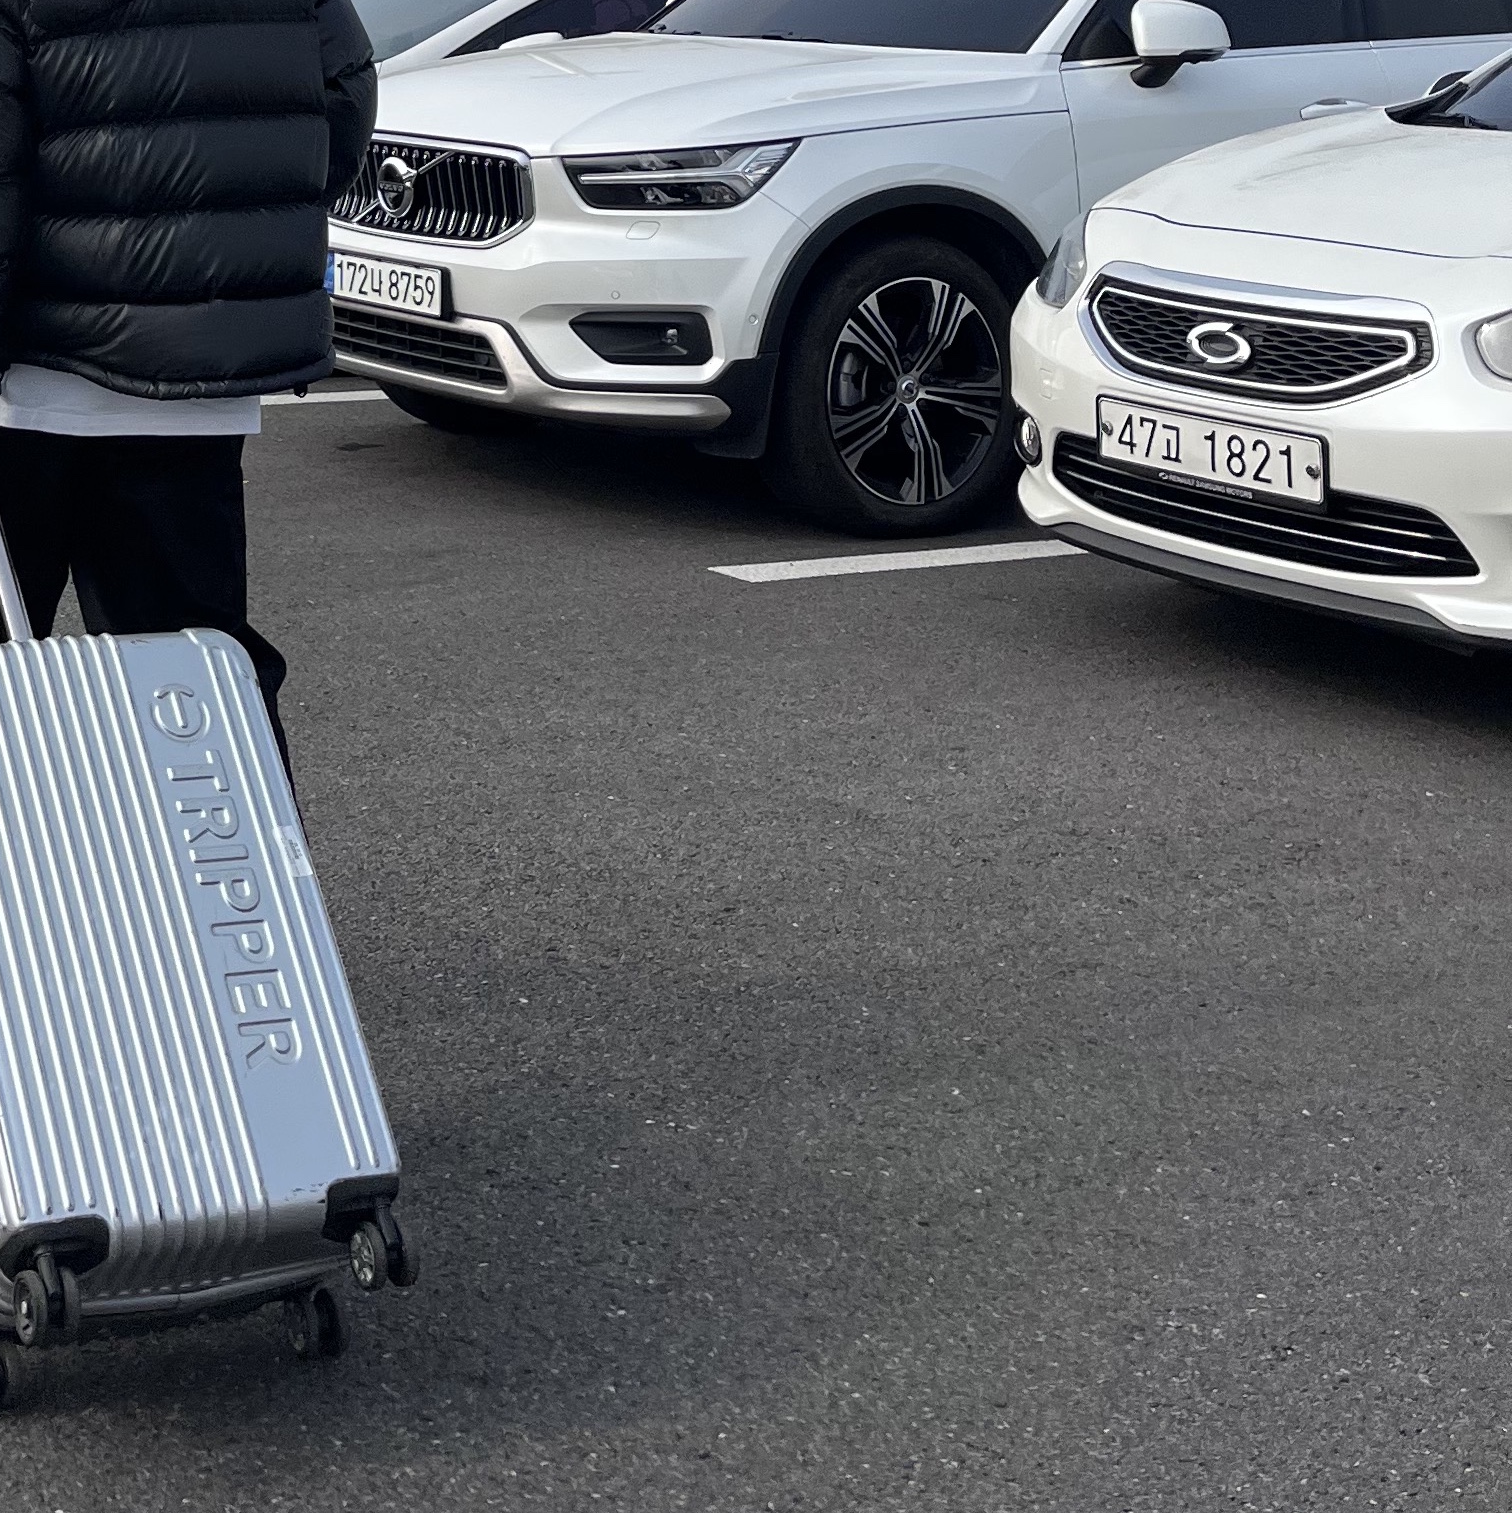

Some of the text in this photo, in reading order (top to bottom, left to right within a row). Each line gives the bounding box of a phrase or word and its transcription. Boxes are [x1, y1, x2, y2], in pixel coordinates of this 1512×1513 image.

[336, 259, 436, 308] 172나 8759
[1117, 413, 1293, 489] 47고 1821
[167, 749, 303, 1070] TRIPPER
